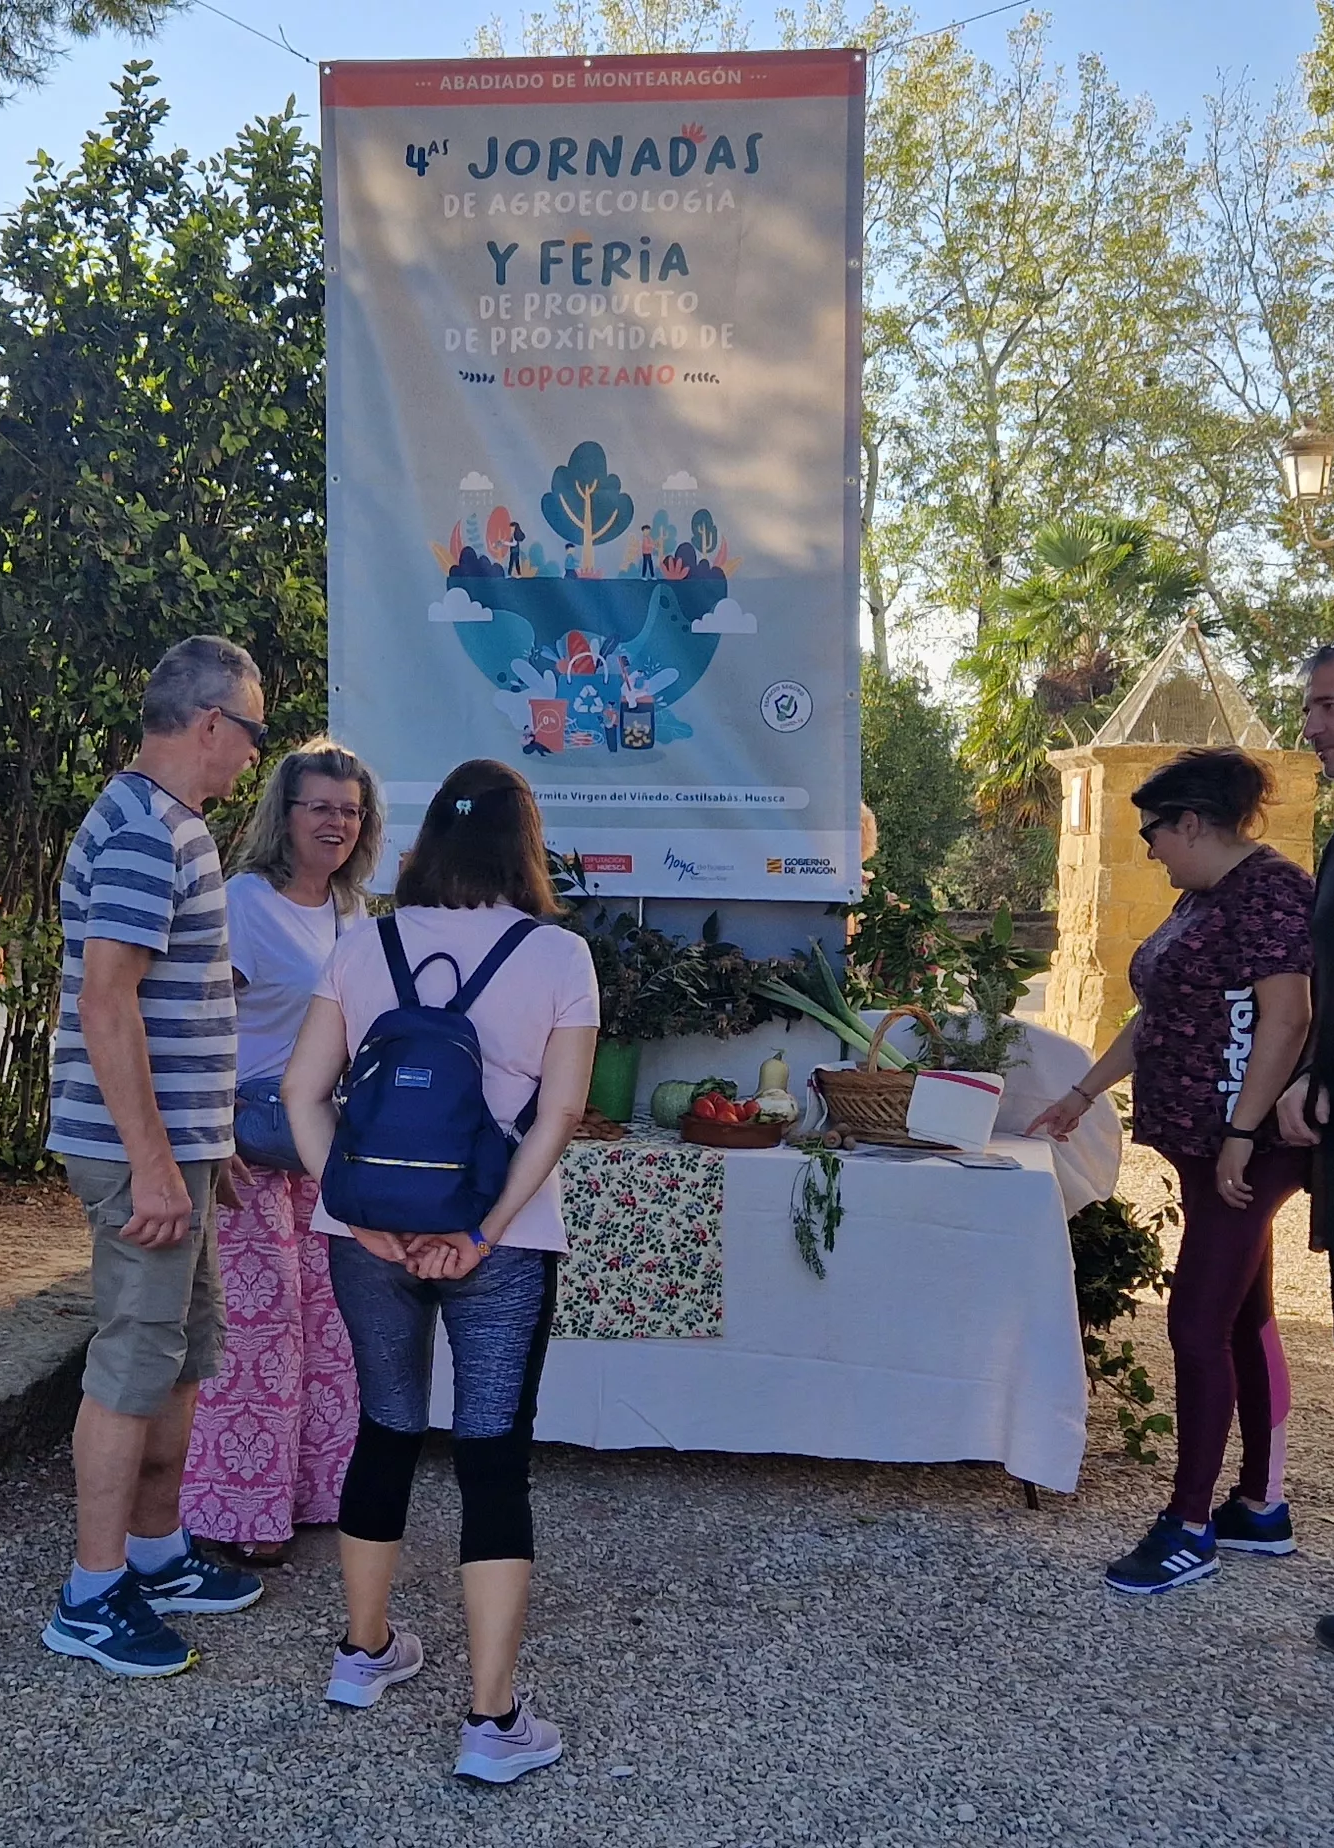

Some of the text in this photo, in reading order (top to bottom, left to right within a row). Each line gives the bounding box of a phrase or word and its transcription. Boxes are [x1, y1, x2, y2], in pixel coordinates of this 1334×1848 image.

[439, 66, 742, 91] ABADIADO DE MONTEARAGÓN
[468, 132, 763, 181] JORNADAS
[443, 183, 735, 219] DE AGROECOLOGÍA
[486, 240, 519, 286] Y
[479, 290, 699, 322] DE PRODUCTO
[444, 327, 478, 353] DE
[699, 323, 734, 350] DE
[503, 364, 676, 391] LOPORZANO
[570, 791, 607, 803] Virgen
[610, 791, 627, 802] del
[745, 792, 785, 803] Huesca
[596, 864, 627, 872] HUESCA
[663, 847, 700, 882] hoya
[784, 858, 831, 866] GOBIERNO
[784, 866, 796, 875] DE
